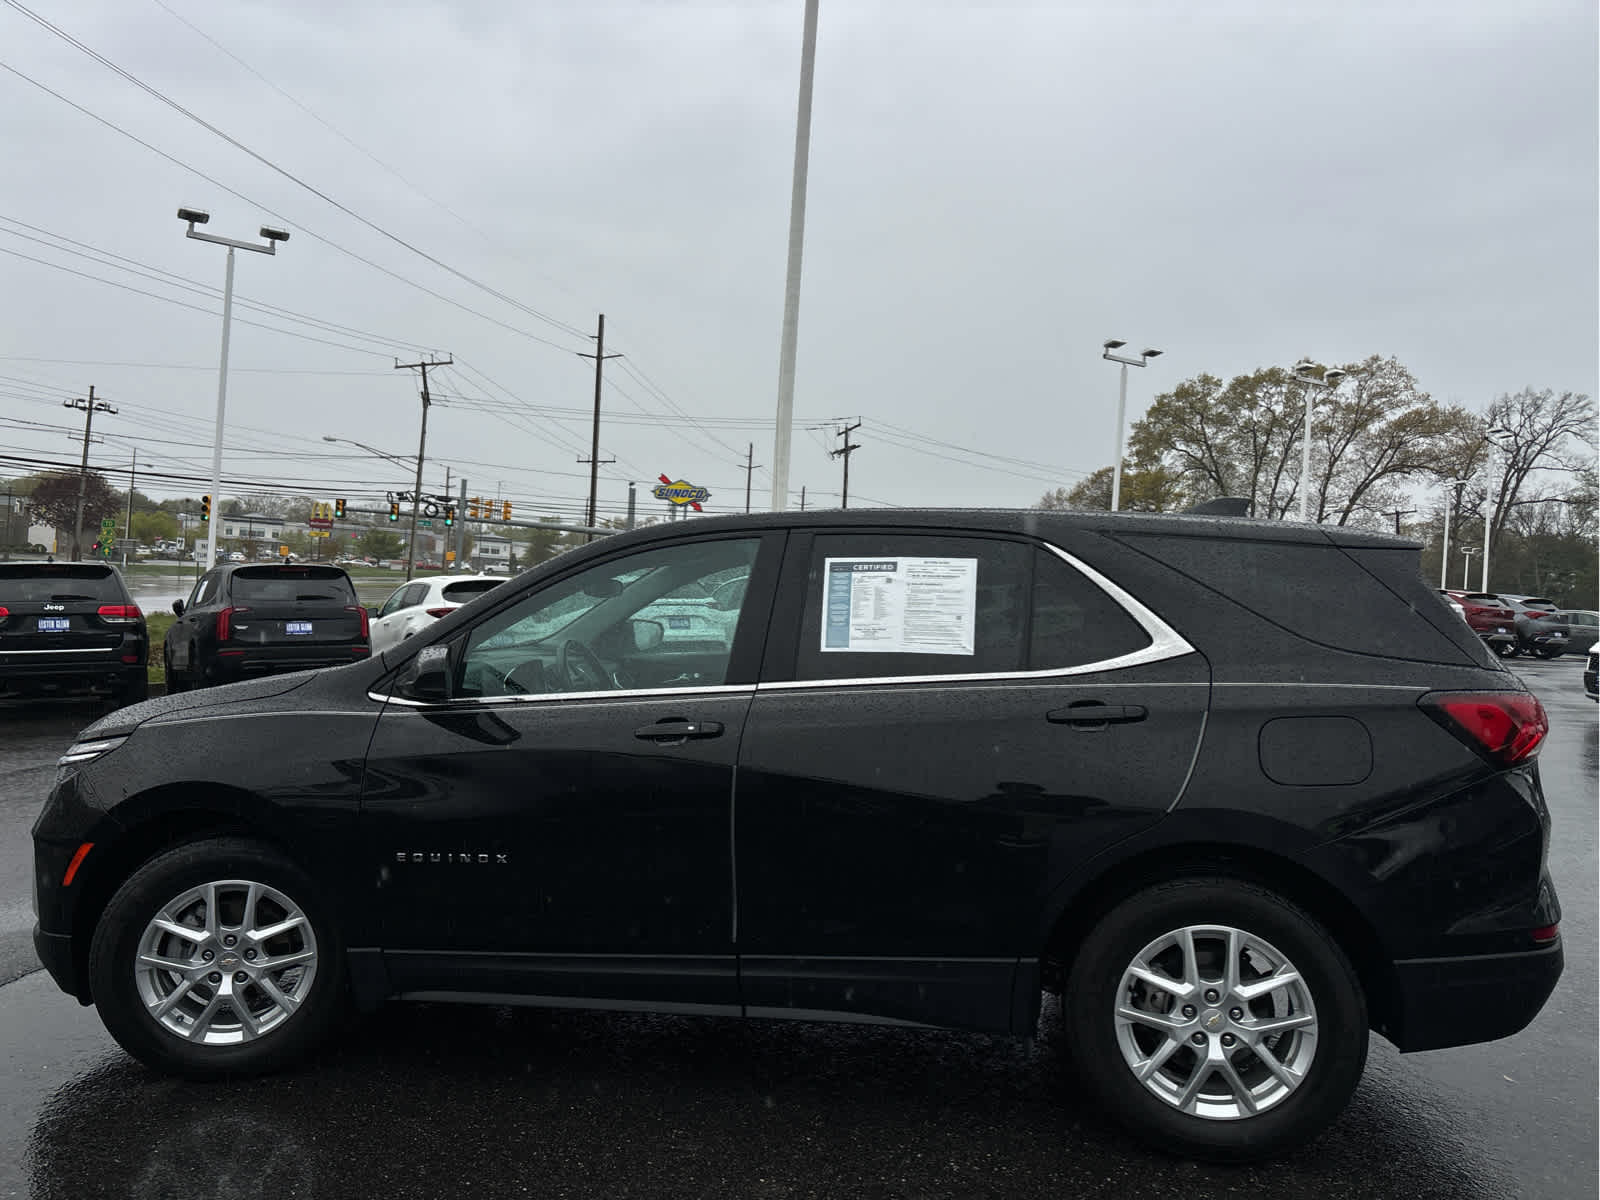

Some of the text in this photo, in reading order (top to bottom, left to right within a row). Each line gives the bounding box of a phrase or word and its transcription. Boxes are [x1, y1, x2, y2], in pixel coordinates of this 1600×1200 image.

[657, 487, 705, 499] SUNOCO
[853, 564, 895, 572] CERTIFIED
[43, 603, 65, 612] Jeep
[396, 852, 508, 864] EQUINOX
